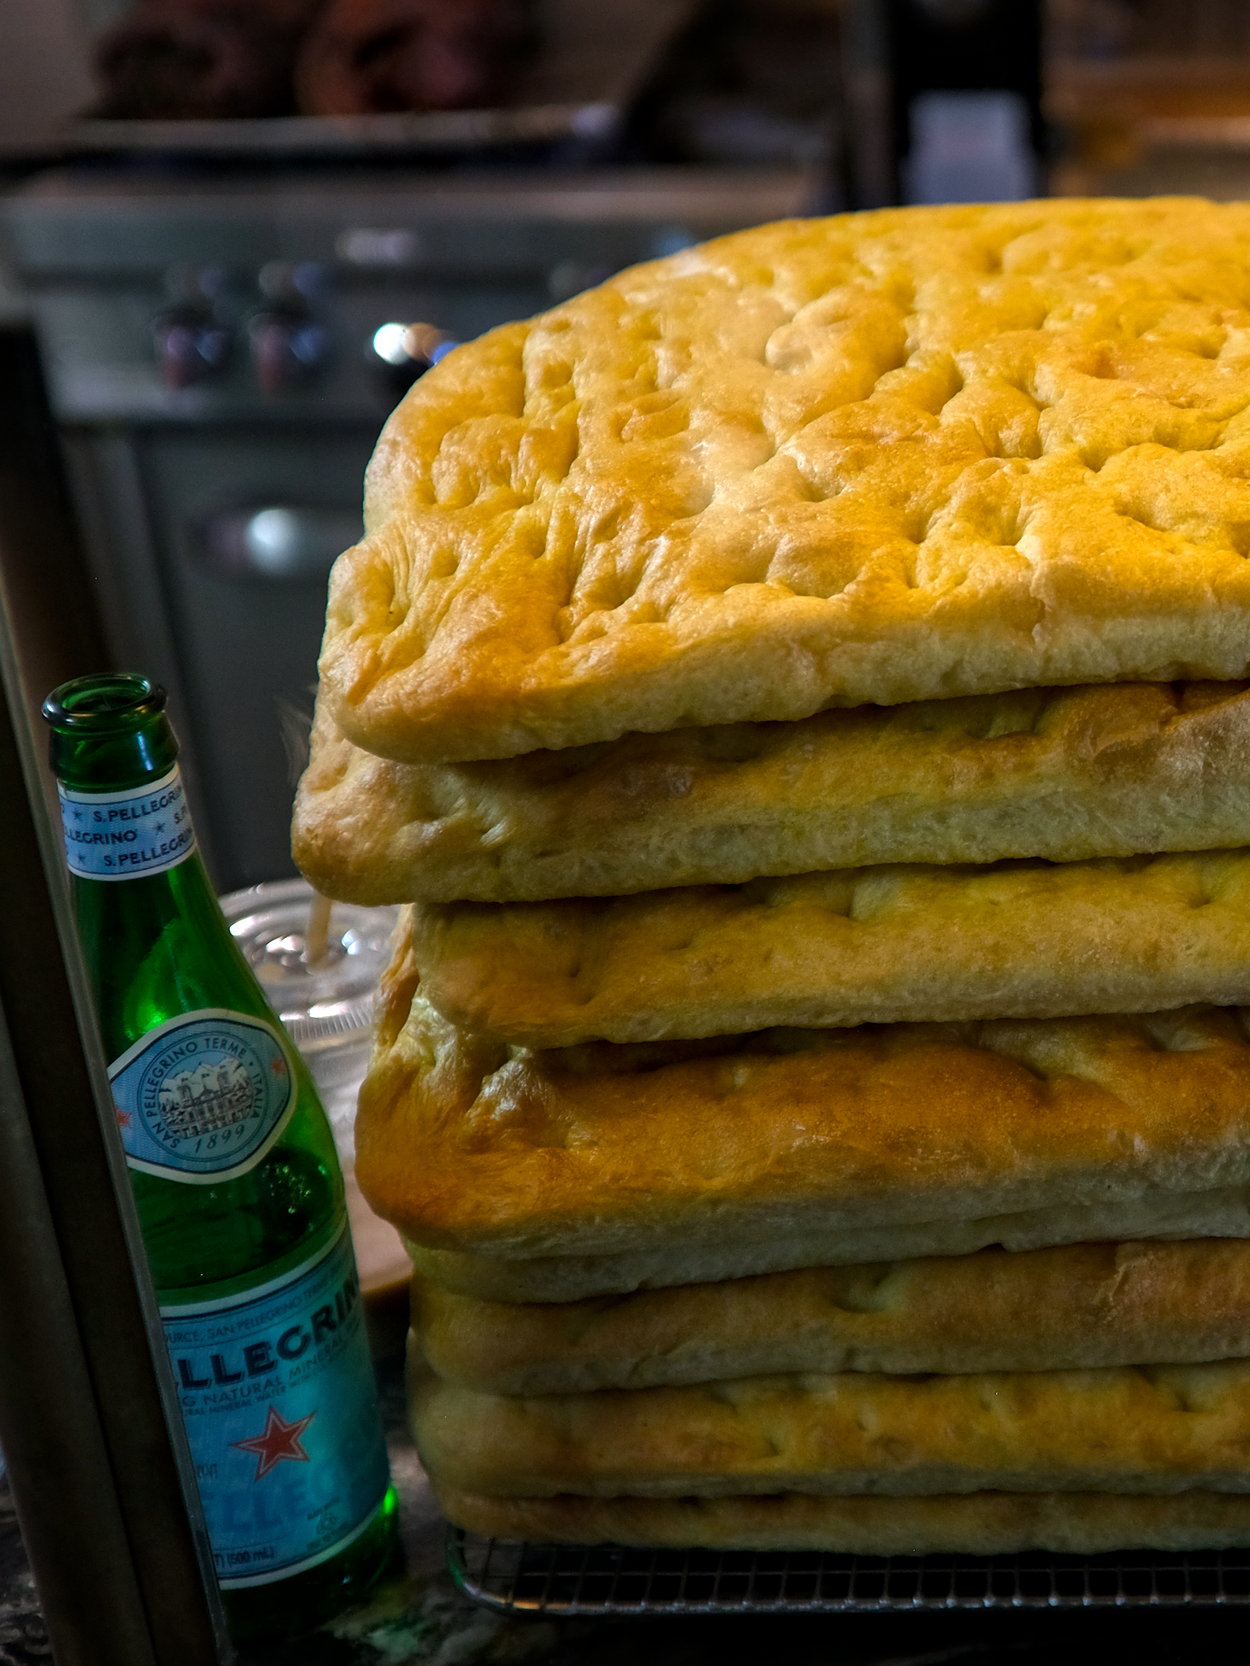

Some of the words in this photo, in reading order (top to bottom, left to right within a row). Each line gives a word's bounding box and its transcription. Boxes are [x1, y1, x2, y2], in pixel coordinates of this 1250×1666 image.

[204, 1037, 248, 1059] TERME
[143, 1041, 199, 1118] PELLEGRINO
[250, 1072, 264, 1120] ITALIA
[151, 1122, 182, 1149] SAN
[193, 1123, 246, 1153] 1899
[203, 1375, 284, 1405] NATURAL
